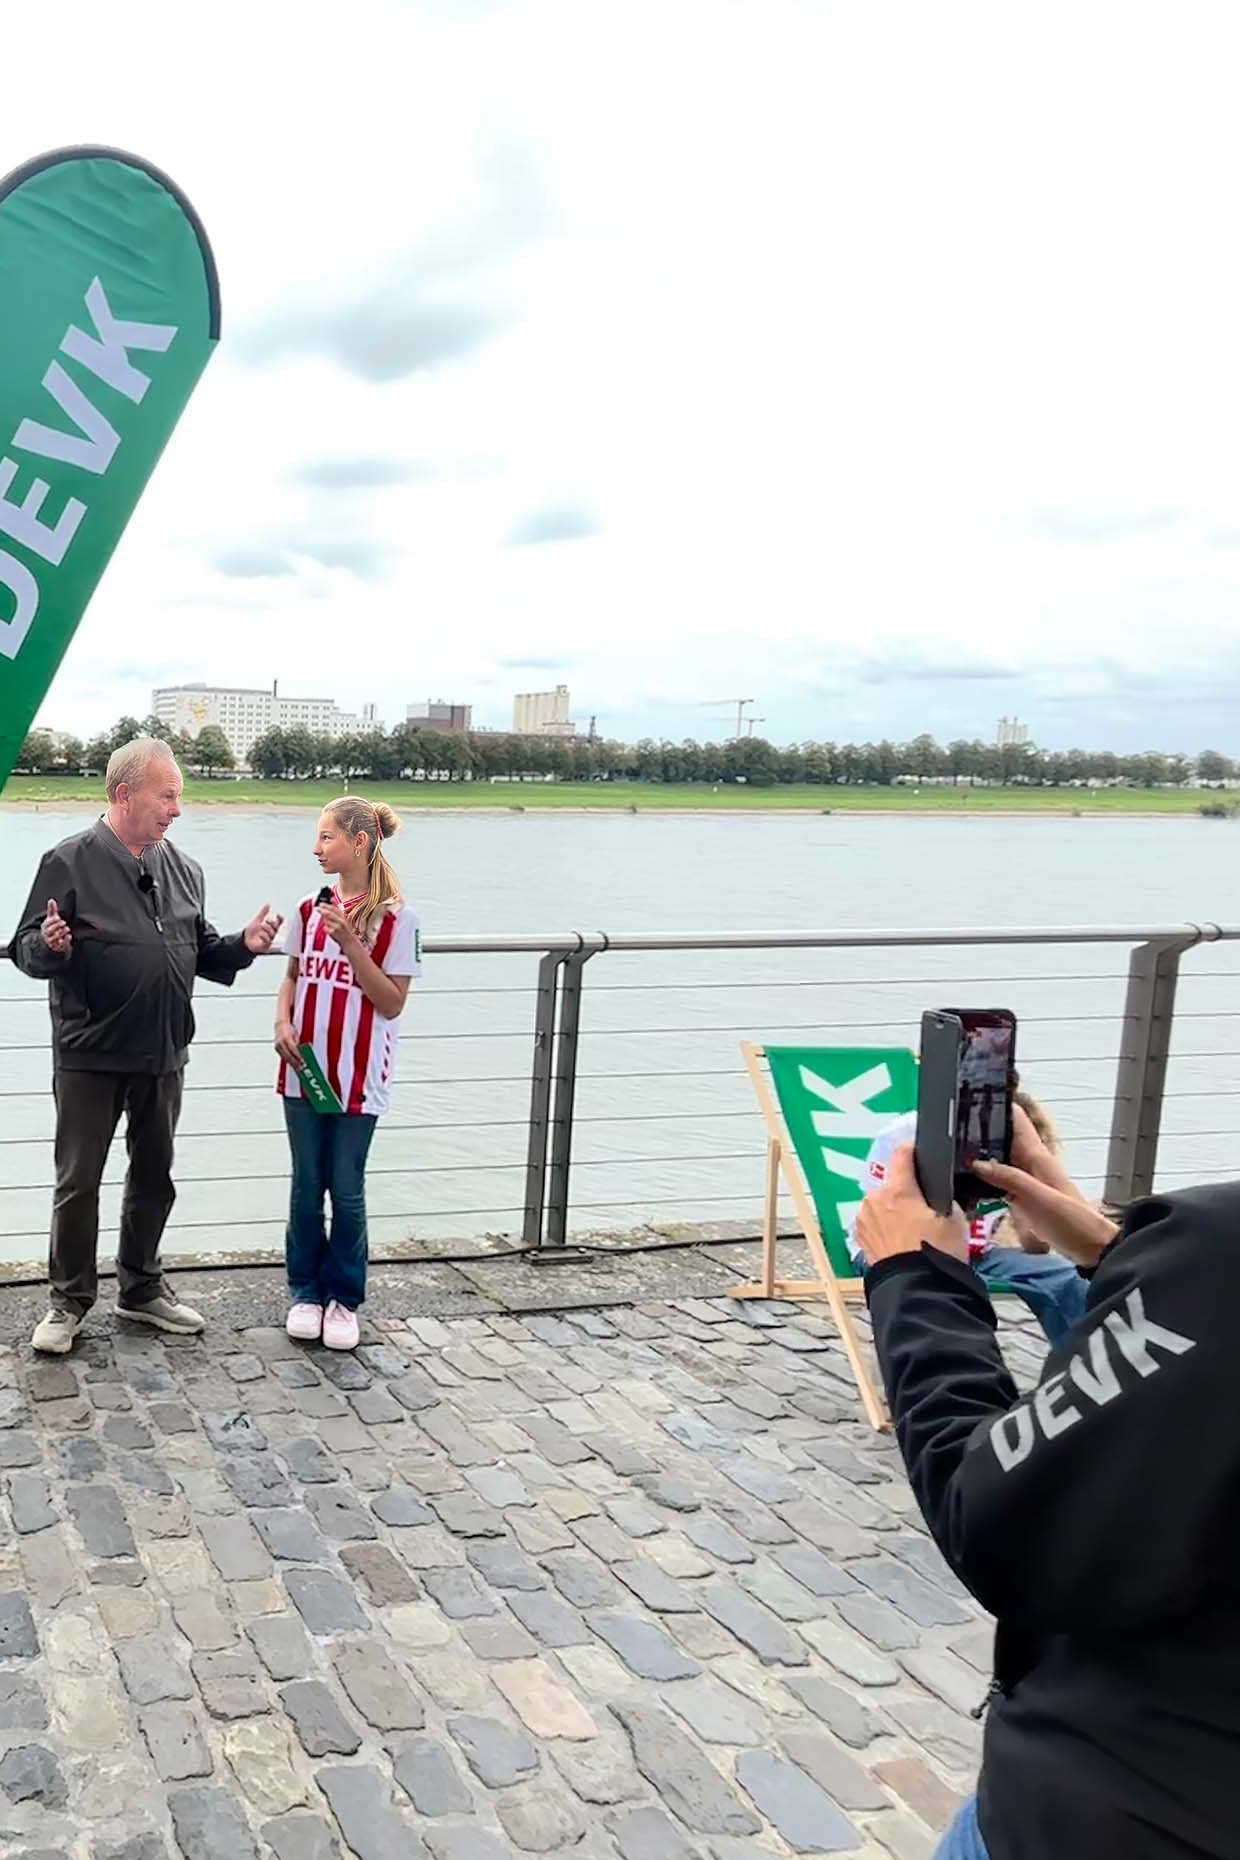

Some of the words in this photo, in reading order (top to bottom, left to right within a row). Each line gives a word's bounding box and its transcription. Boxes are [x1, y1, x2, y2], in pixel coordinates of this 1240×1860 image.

[298, 956, 351, 984] EWE
[302, 1062, 328, 1101] EVK
[990, 1287, 1197, 1473] DEVK
